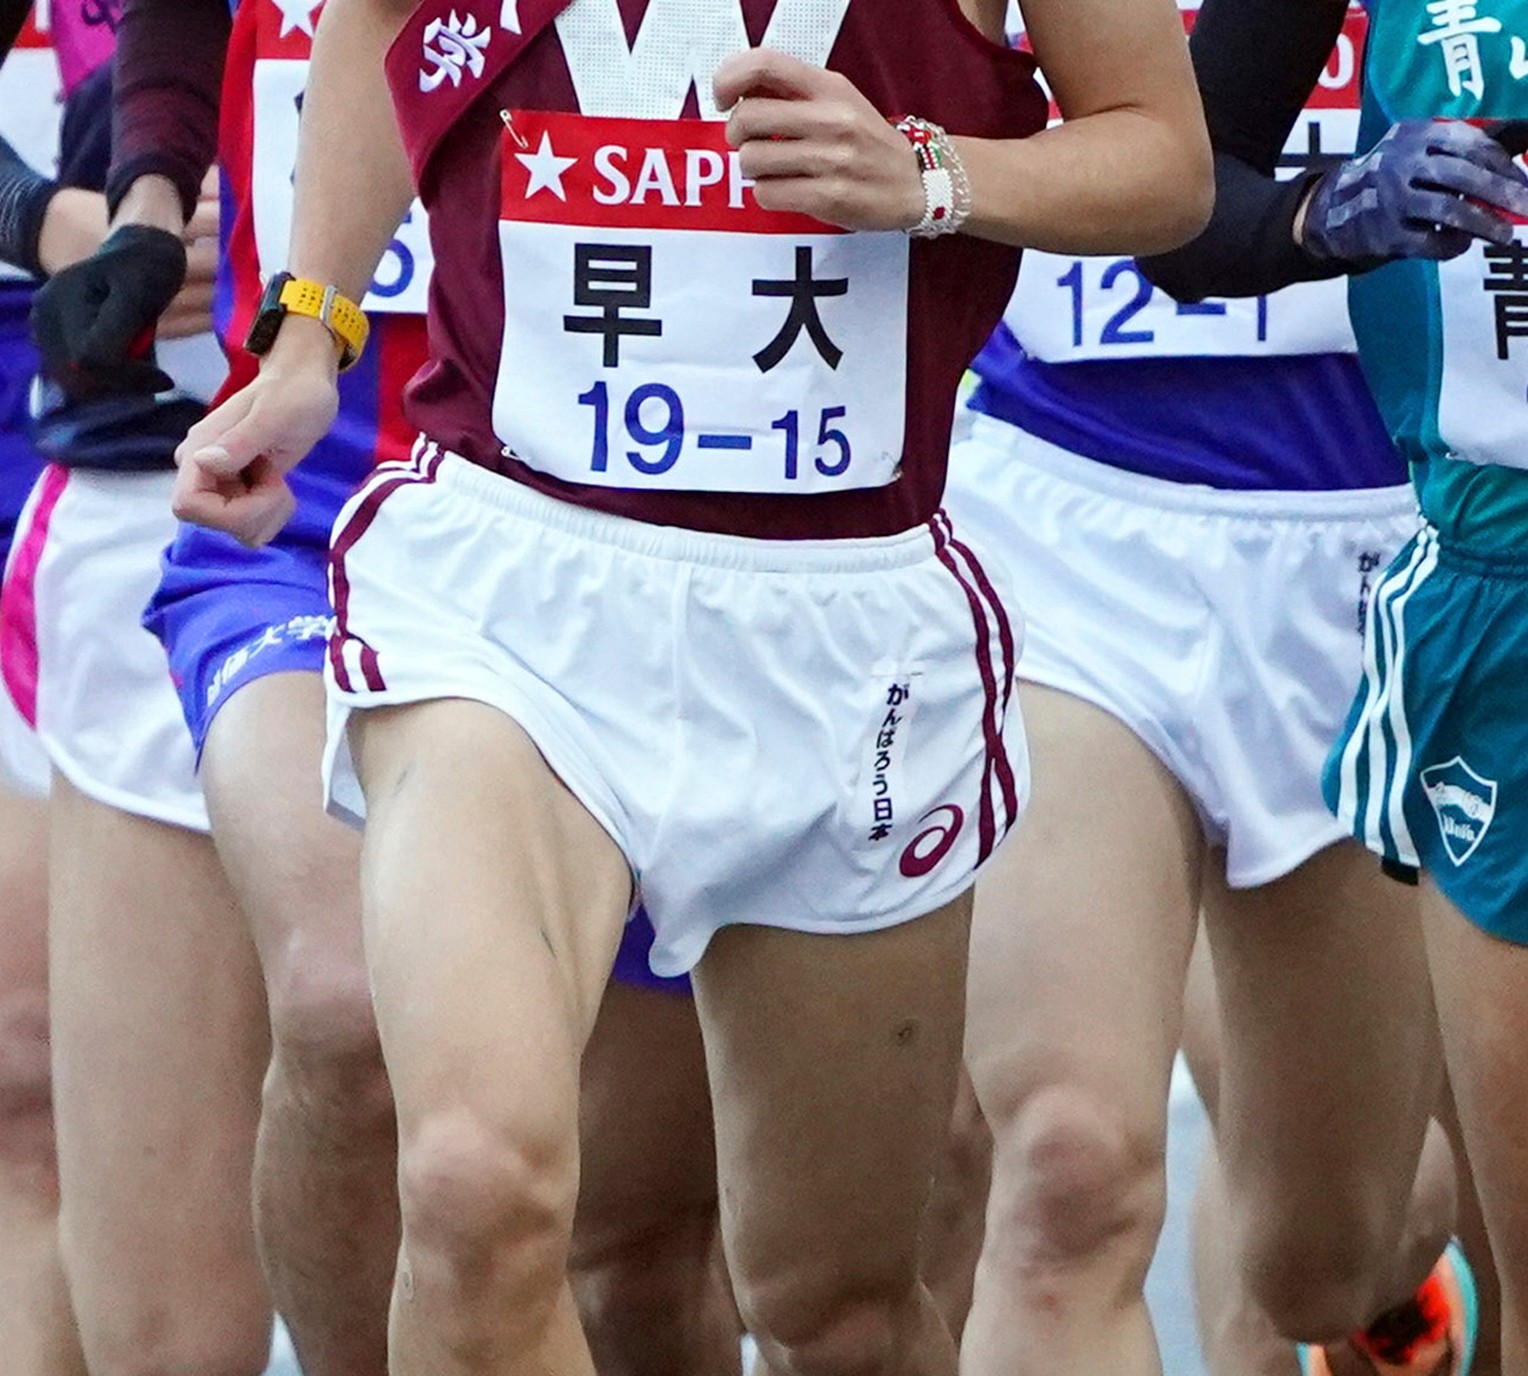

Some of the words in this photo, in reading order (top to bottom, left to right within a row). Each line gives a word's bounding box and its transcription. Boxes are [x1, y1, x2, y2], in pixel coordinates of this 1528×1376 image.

[578, 381, 851, 480] 19-15
[867, 683, 910, 841] がんばろう日本
